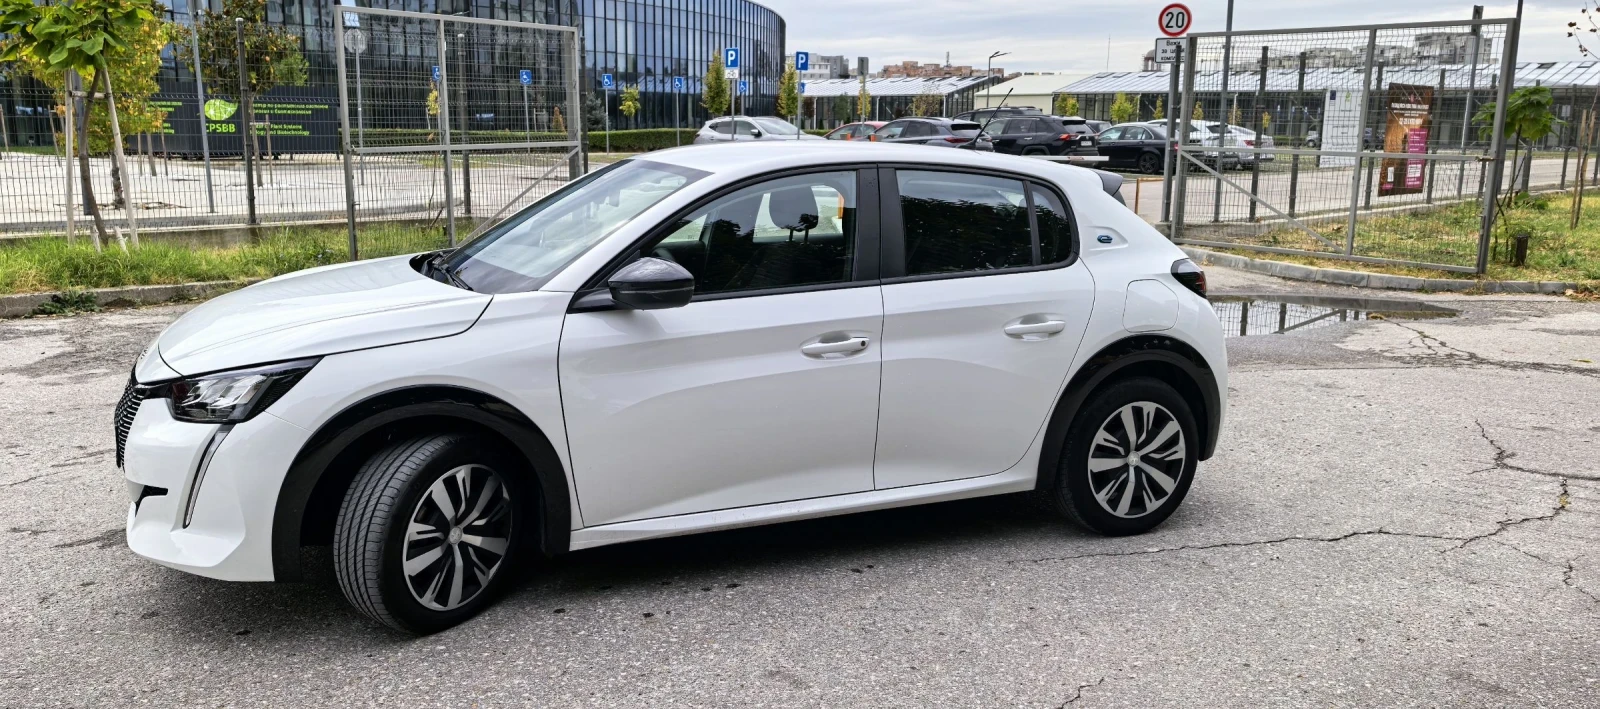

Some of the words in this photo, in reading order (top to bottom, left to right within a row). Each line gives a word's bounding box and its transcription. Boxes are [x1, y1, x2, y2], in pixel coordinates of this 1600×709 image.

[1165, 11, 1185, 28] 20
[727, 50, 736, 66] P
[798, 54, 806, 68] P
